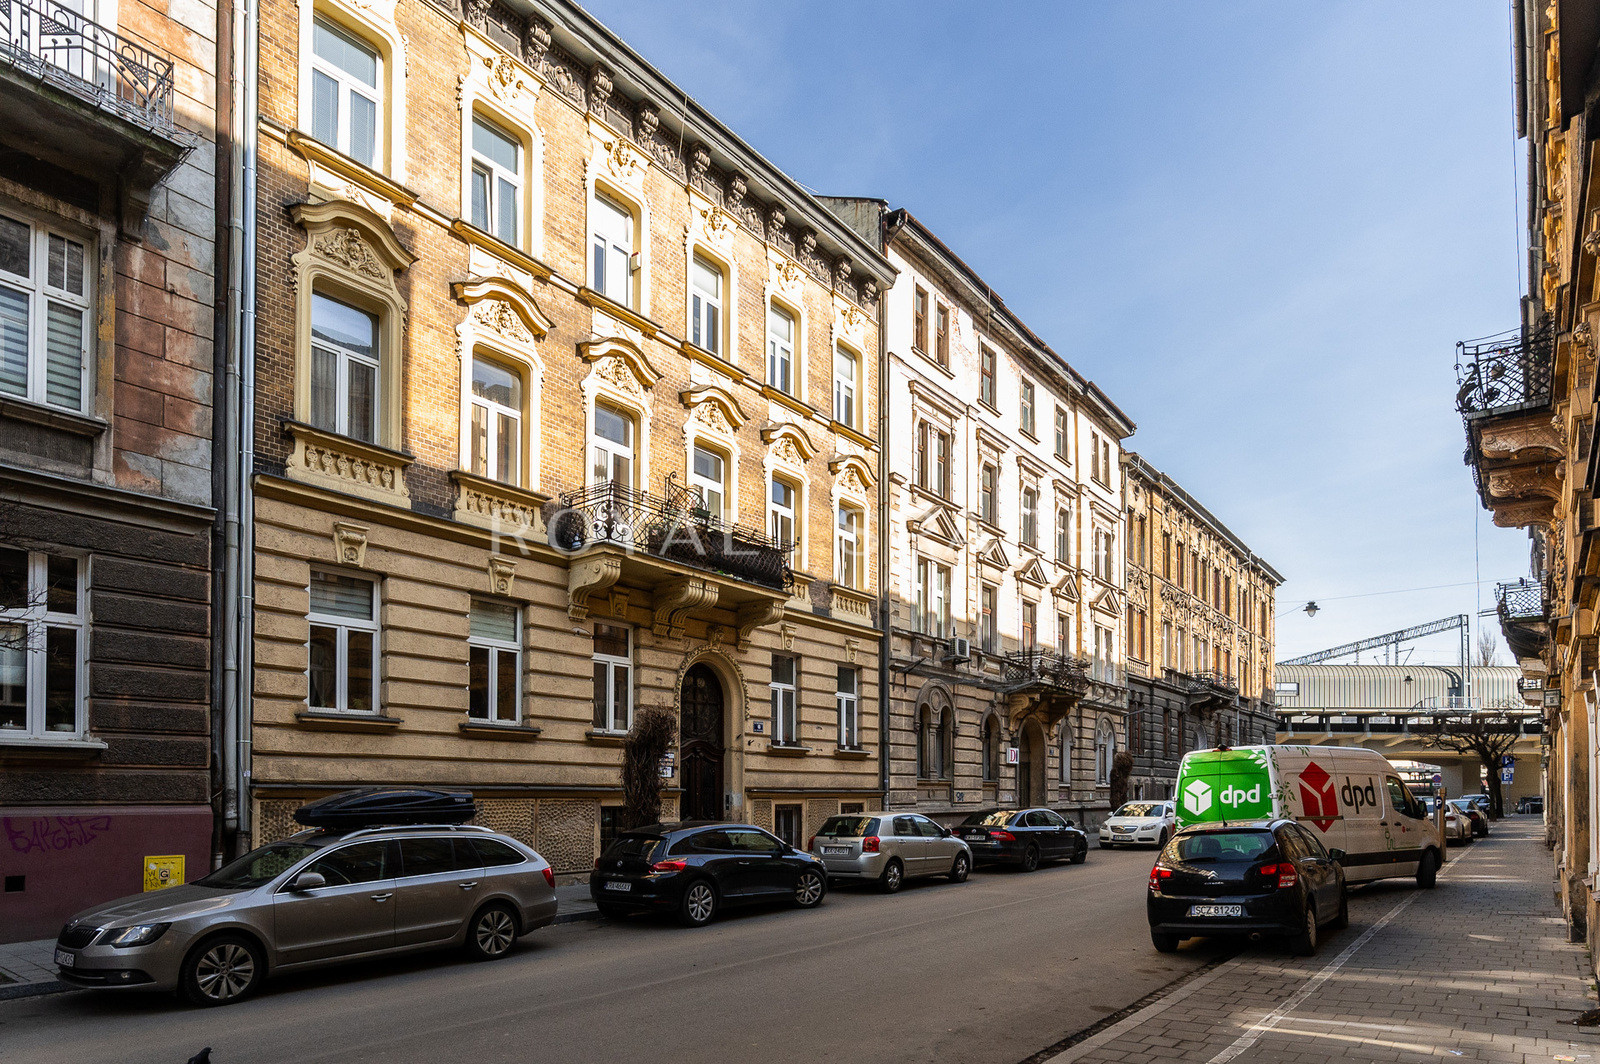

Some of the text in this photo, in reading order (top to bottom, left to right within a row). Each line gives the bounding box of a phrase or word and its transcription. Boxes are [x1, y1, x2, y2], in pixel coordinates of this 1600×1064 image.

[1219, 783, 1260, 808] dpd
[1341, 777, 1376, 814] dpd
[160, 870, 169, 878] G
[1195, 906, 1241, 915] SCZ 81249
